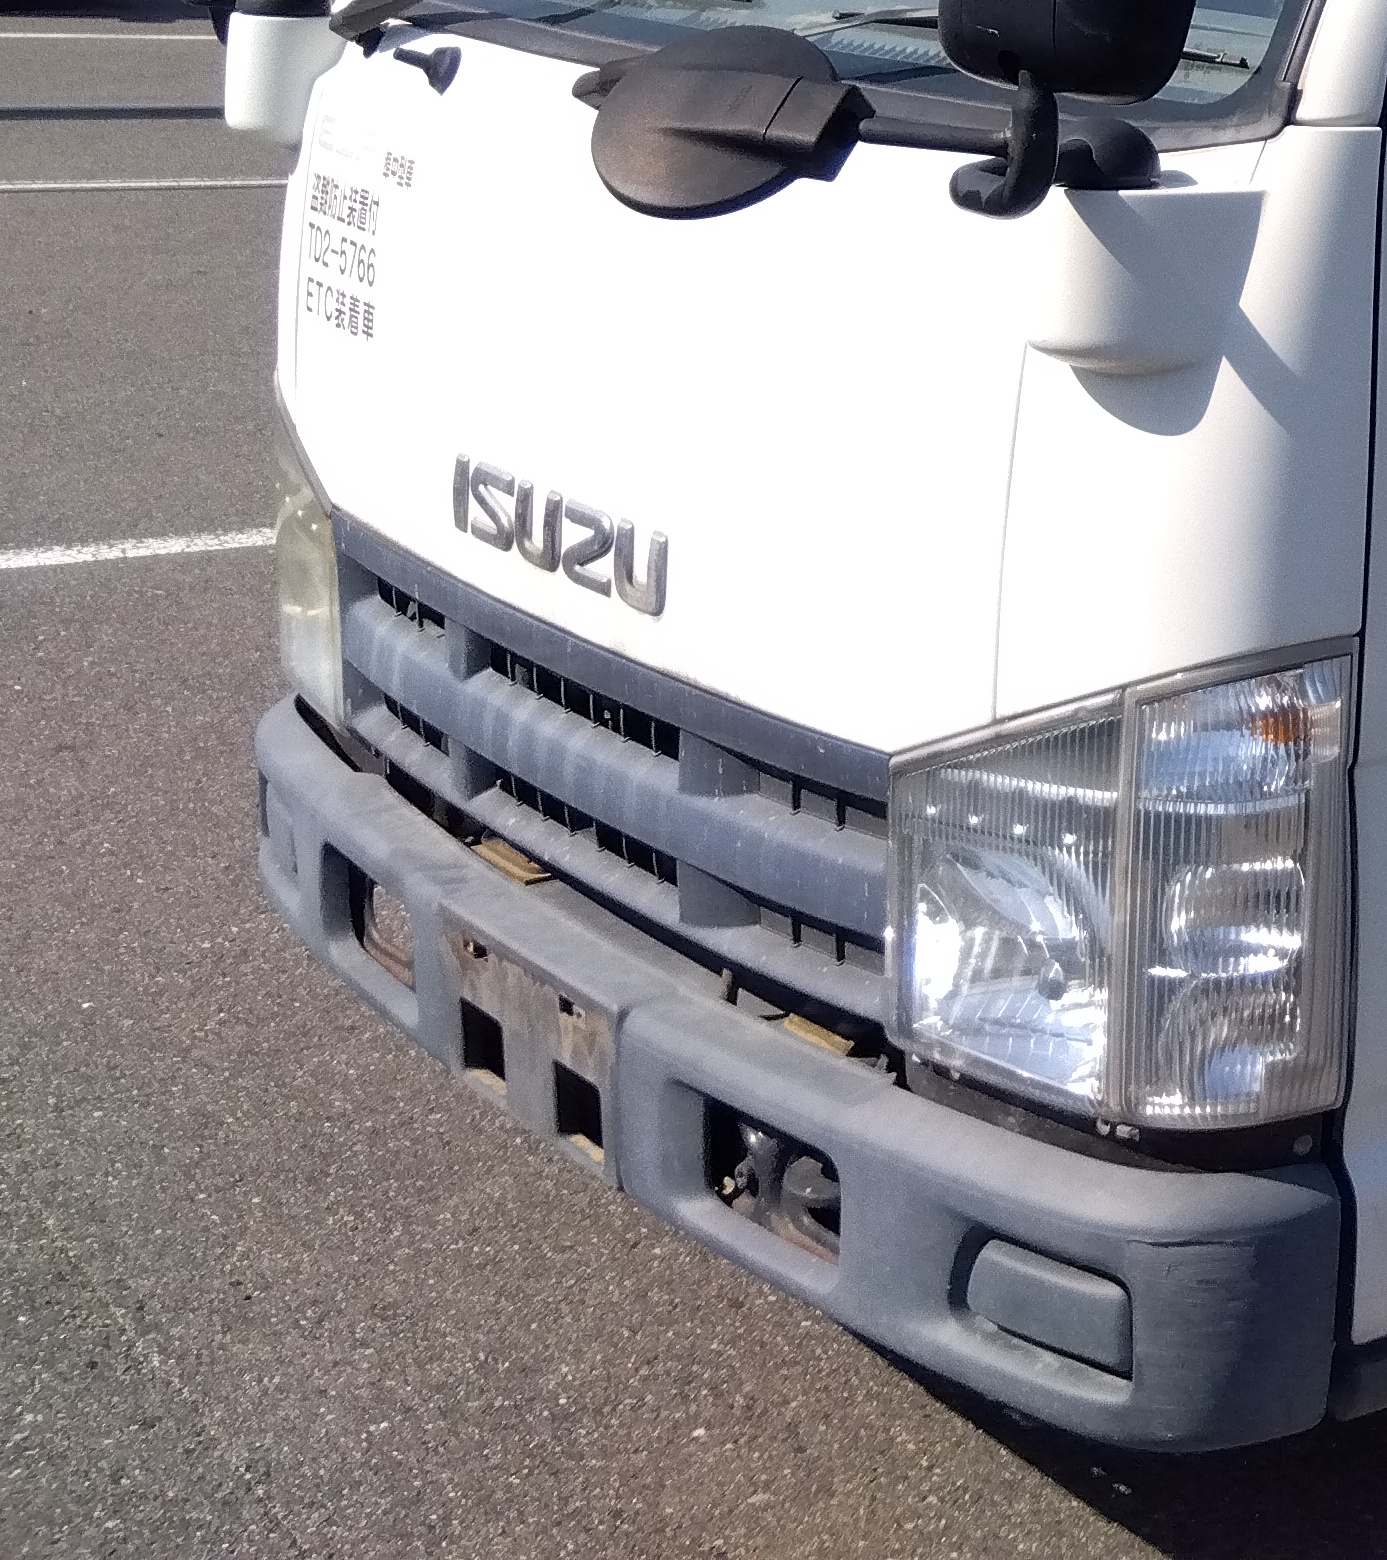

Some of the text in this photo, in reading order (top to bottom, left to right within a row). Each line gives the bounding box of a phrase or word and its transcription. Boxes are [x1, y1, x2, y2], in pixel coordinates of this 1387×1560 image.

[308, 221, 377, 288] TD2-5766
[305, 276, 376, 343] ETC装着車
[452, 452, 669, 618] ISUZU
